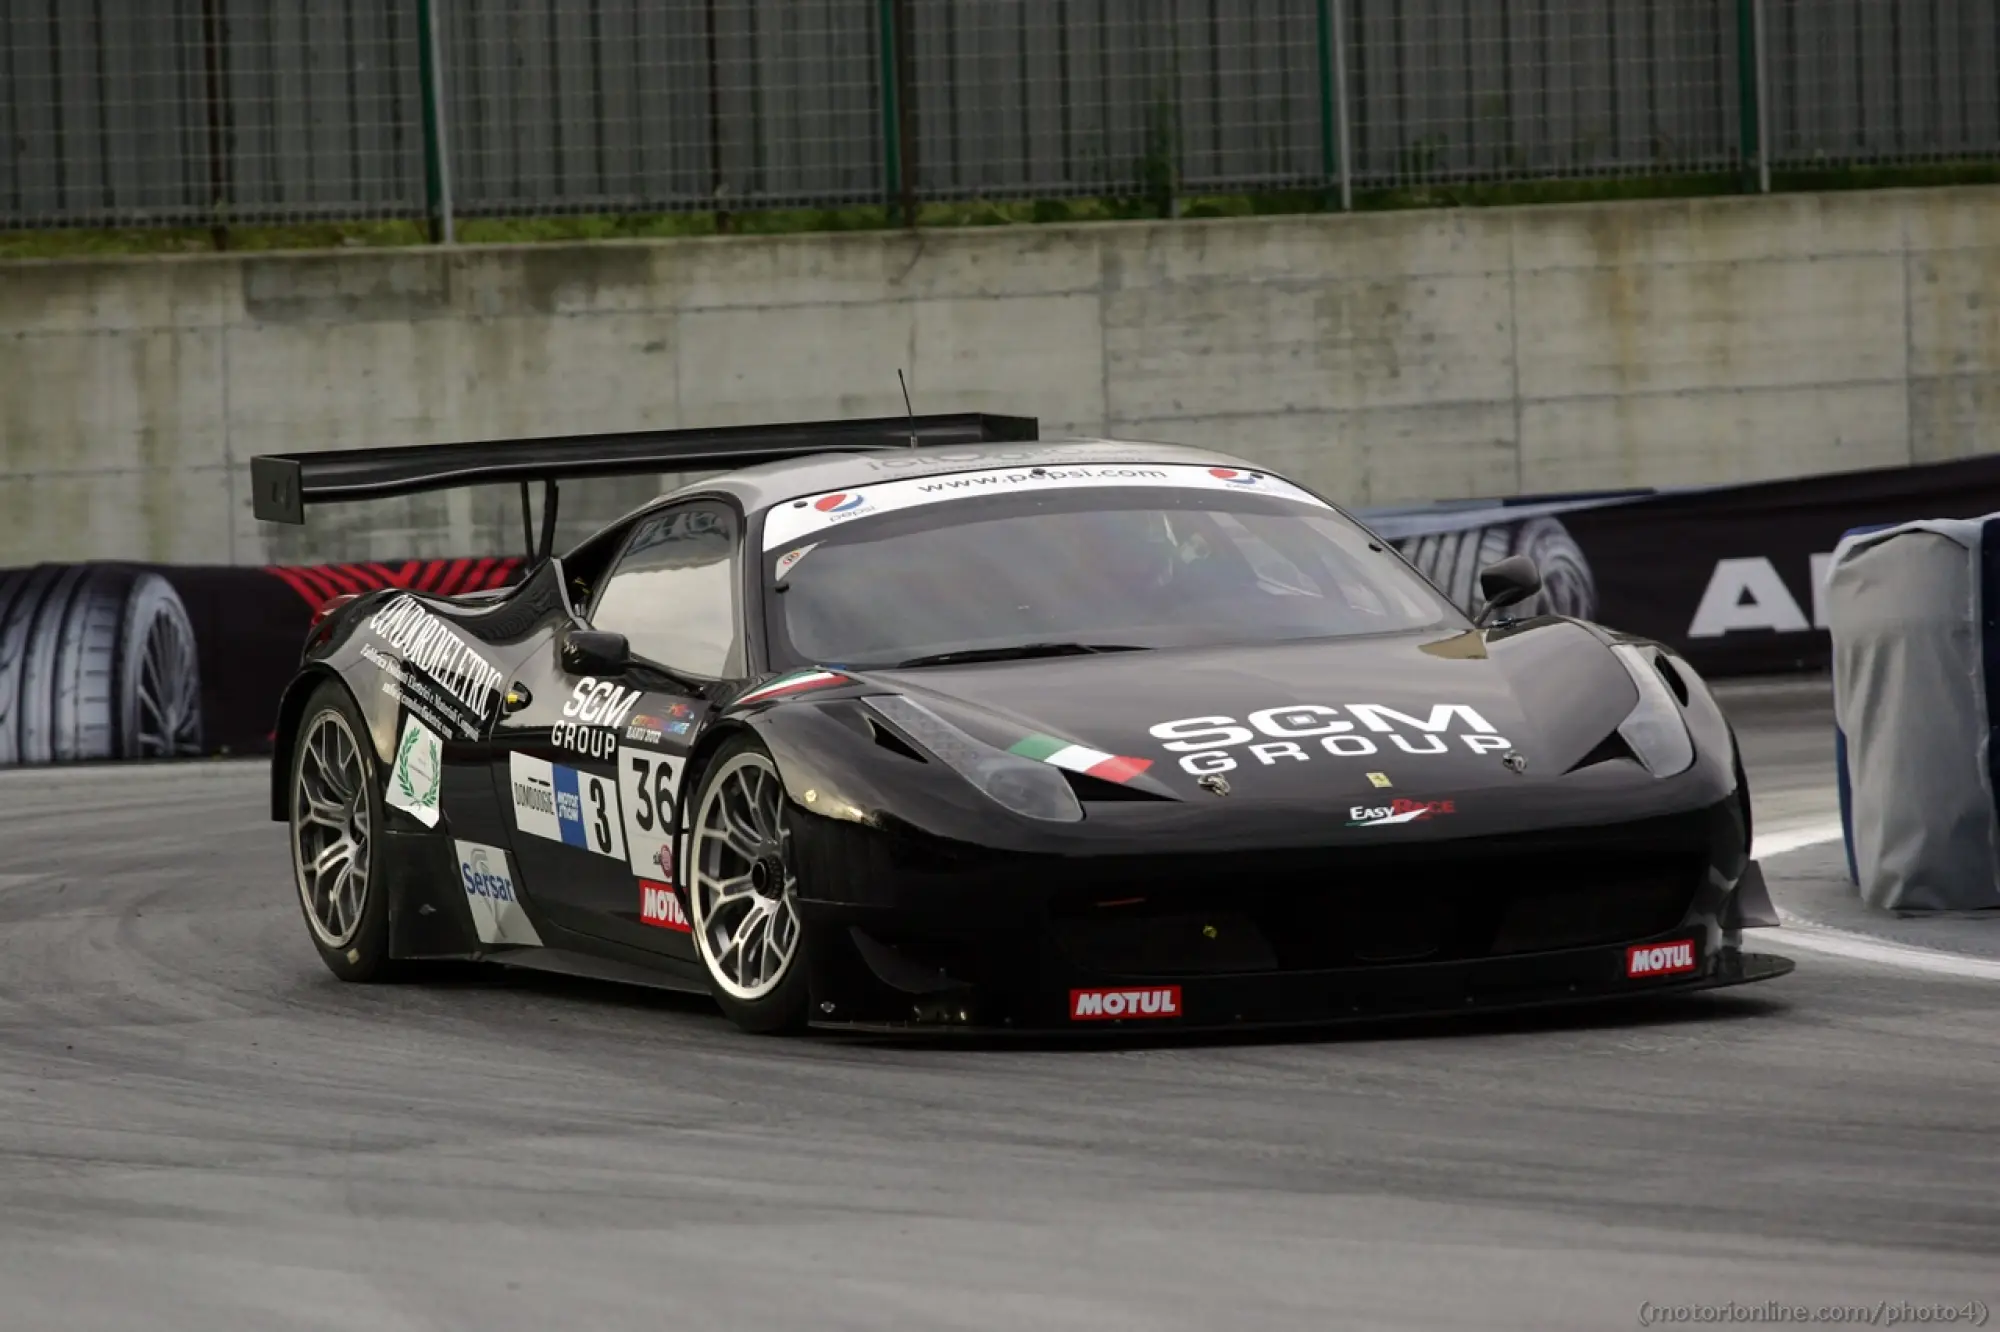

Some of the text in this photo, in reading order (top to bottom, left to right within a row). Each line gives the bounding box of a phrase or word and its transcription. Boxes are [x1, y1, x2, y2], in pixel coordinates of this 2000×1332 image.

[918, 467, 1167, 493] www.pepsi.com
[1687, 552, 1832, 639] A
[563, 676, 643, 729] SCM
[551, 719, 617, 760] GROUP
[1149, 704, 1498, 751] SCM
[1178, 734, 1512, 775] GROUP
[590, 778, 612, 854] 3
[633, 757, 677, 836] 36
[1631, 944, 1692, 973] MOTUL
[1076, 990, 1176, 1016] MOTUL
